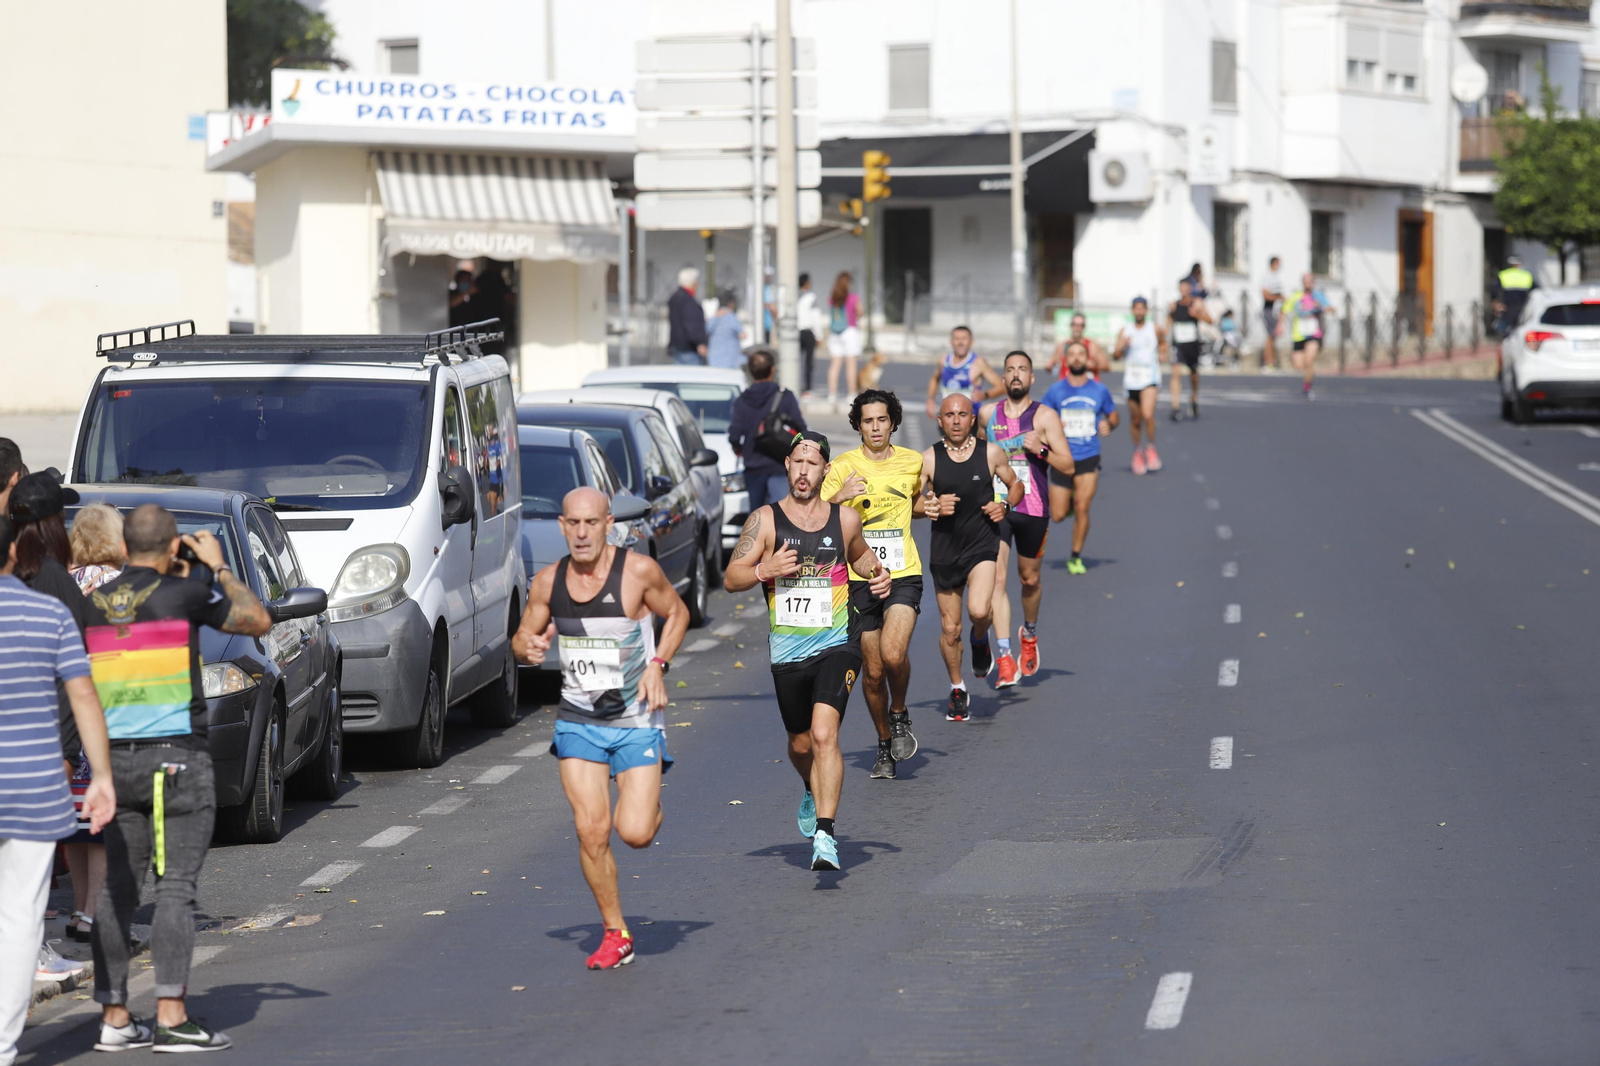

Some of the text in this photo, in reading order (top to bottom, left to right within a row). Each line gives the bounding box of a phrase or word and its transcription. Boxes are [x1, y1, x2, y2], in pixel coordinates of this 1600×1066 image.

[315, 79, 457, 99] CHURROS
[357, 104, 606, 128] PATATAS FRITAS
[785, 597, 811, 613] 177
[569, 659, 596, 675] 401
